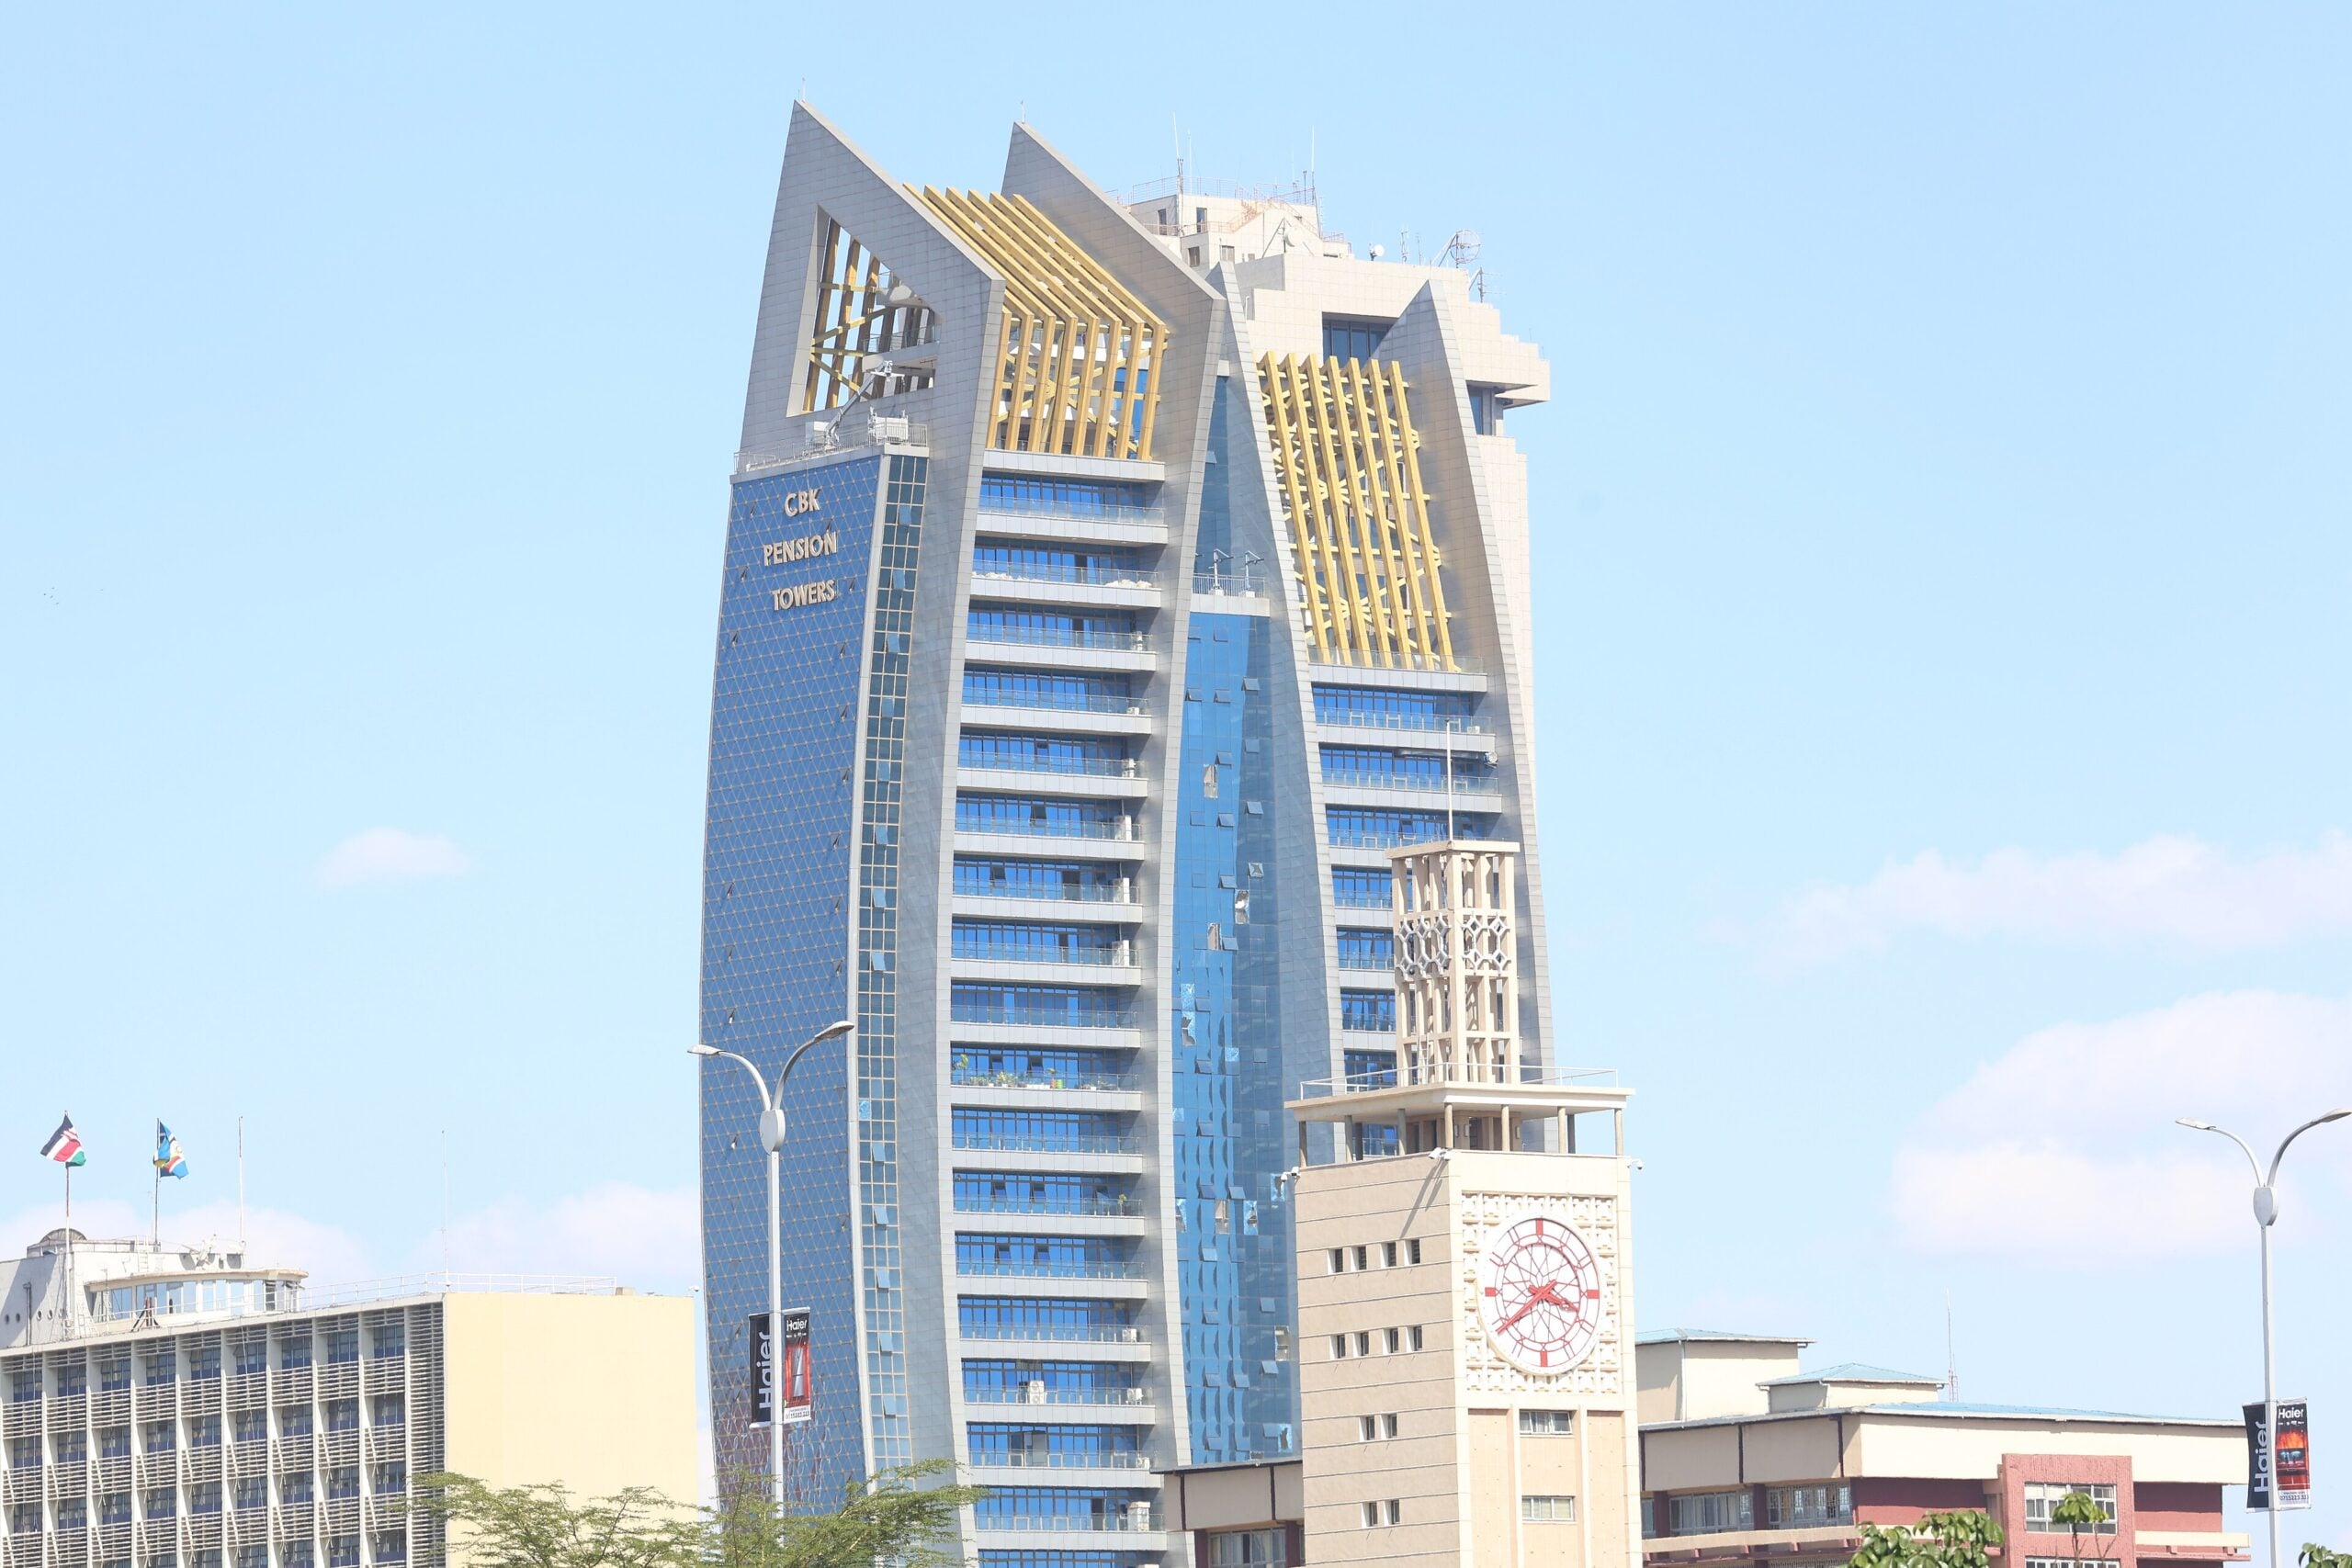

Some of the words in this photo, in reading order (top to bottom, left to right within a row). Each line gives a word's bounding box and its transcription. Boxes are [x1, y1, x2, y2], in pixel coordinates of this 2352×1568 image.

[784, 488, 820, 517] CBK
[763, 531, 837, 566] PENSION
[772, 580, 836, 611] TOWERS
[786, 1318, 808, 1332] Haier
[756, 1331, 771, 1408] Haier
[2278, 1407, 2303, 1419] Haier
[2254, 1420, 2268, 1493] Haier
